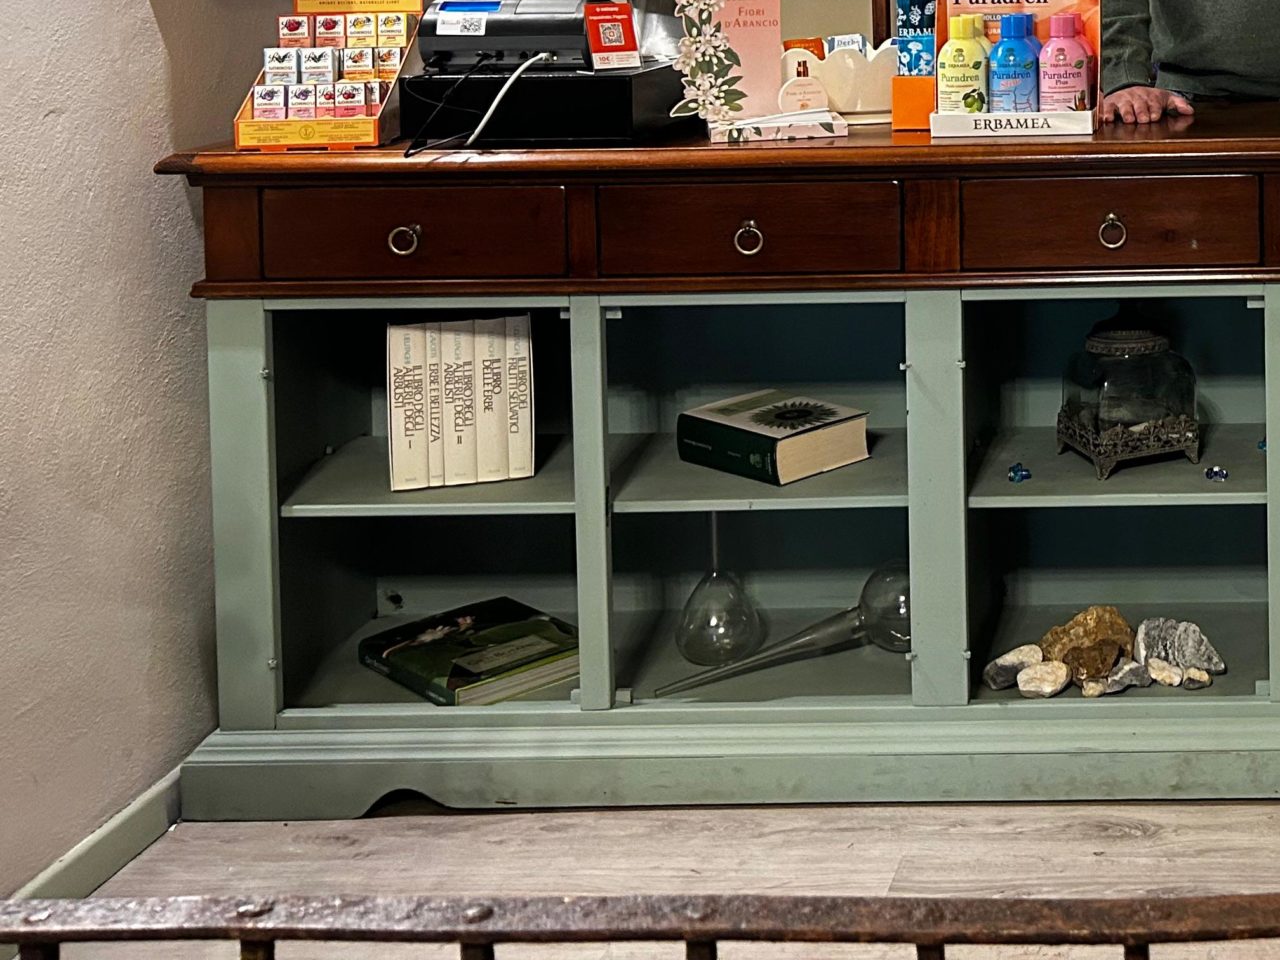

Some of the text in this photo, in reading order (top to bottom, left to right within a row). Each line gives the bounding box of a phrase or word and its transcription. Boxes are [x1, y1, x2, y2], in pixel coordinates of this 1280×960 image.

[941, 73, 980, 82] Puradren
[992, 70, 1031, 80] Puradren
[1042, 70, 1082, 80] Puradren
[973, 118, 1052, 132] ERBAMEA
[394, 367, 404, 408] ARBUSTI
[403, 366, 414, 401] ALBERI
[413, 373, 424, 402] LIBRO
[429, 363, 439, 387] ERBE
[444, 362, 454, 404] ARBUSTI
[453, 362, 463, 396] ALBERI
[463, 369, 473, 397] LIBRO
[482, 359, 493, 413] DELLE ERBE
[492, 366, 502, 395] LIBRO
[518, 365, 528, 392] LIBRO
[508, 357, 519, 434] FRUTTI SELVATICI
[518, 394, 528, 410] DEI
[404, 409, 414, 437] DEGLI
[414, 403, 424, 431] DEGLI
[430, 395, 440, 443] BELLEZZA
[454, 404, 464, 432] DEGLI
[463, 398, 474, 426] DEGLI
